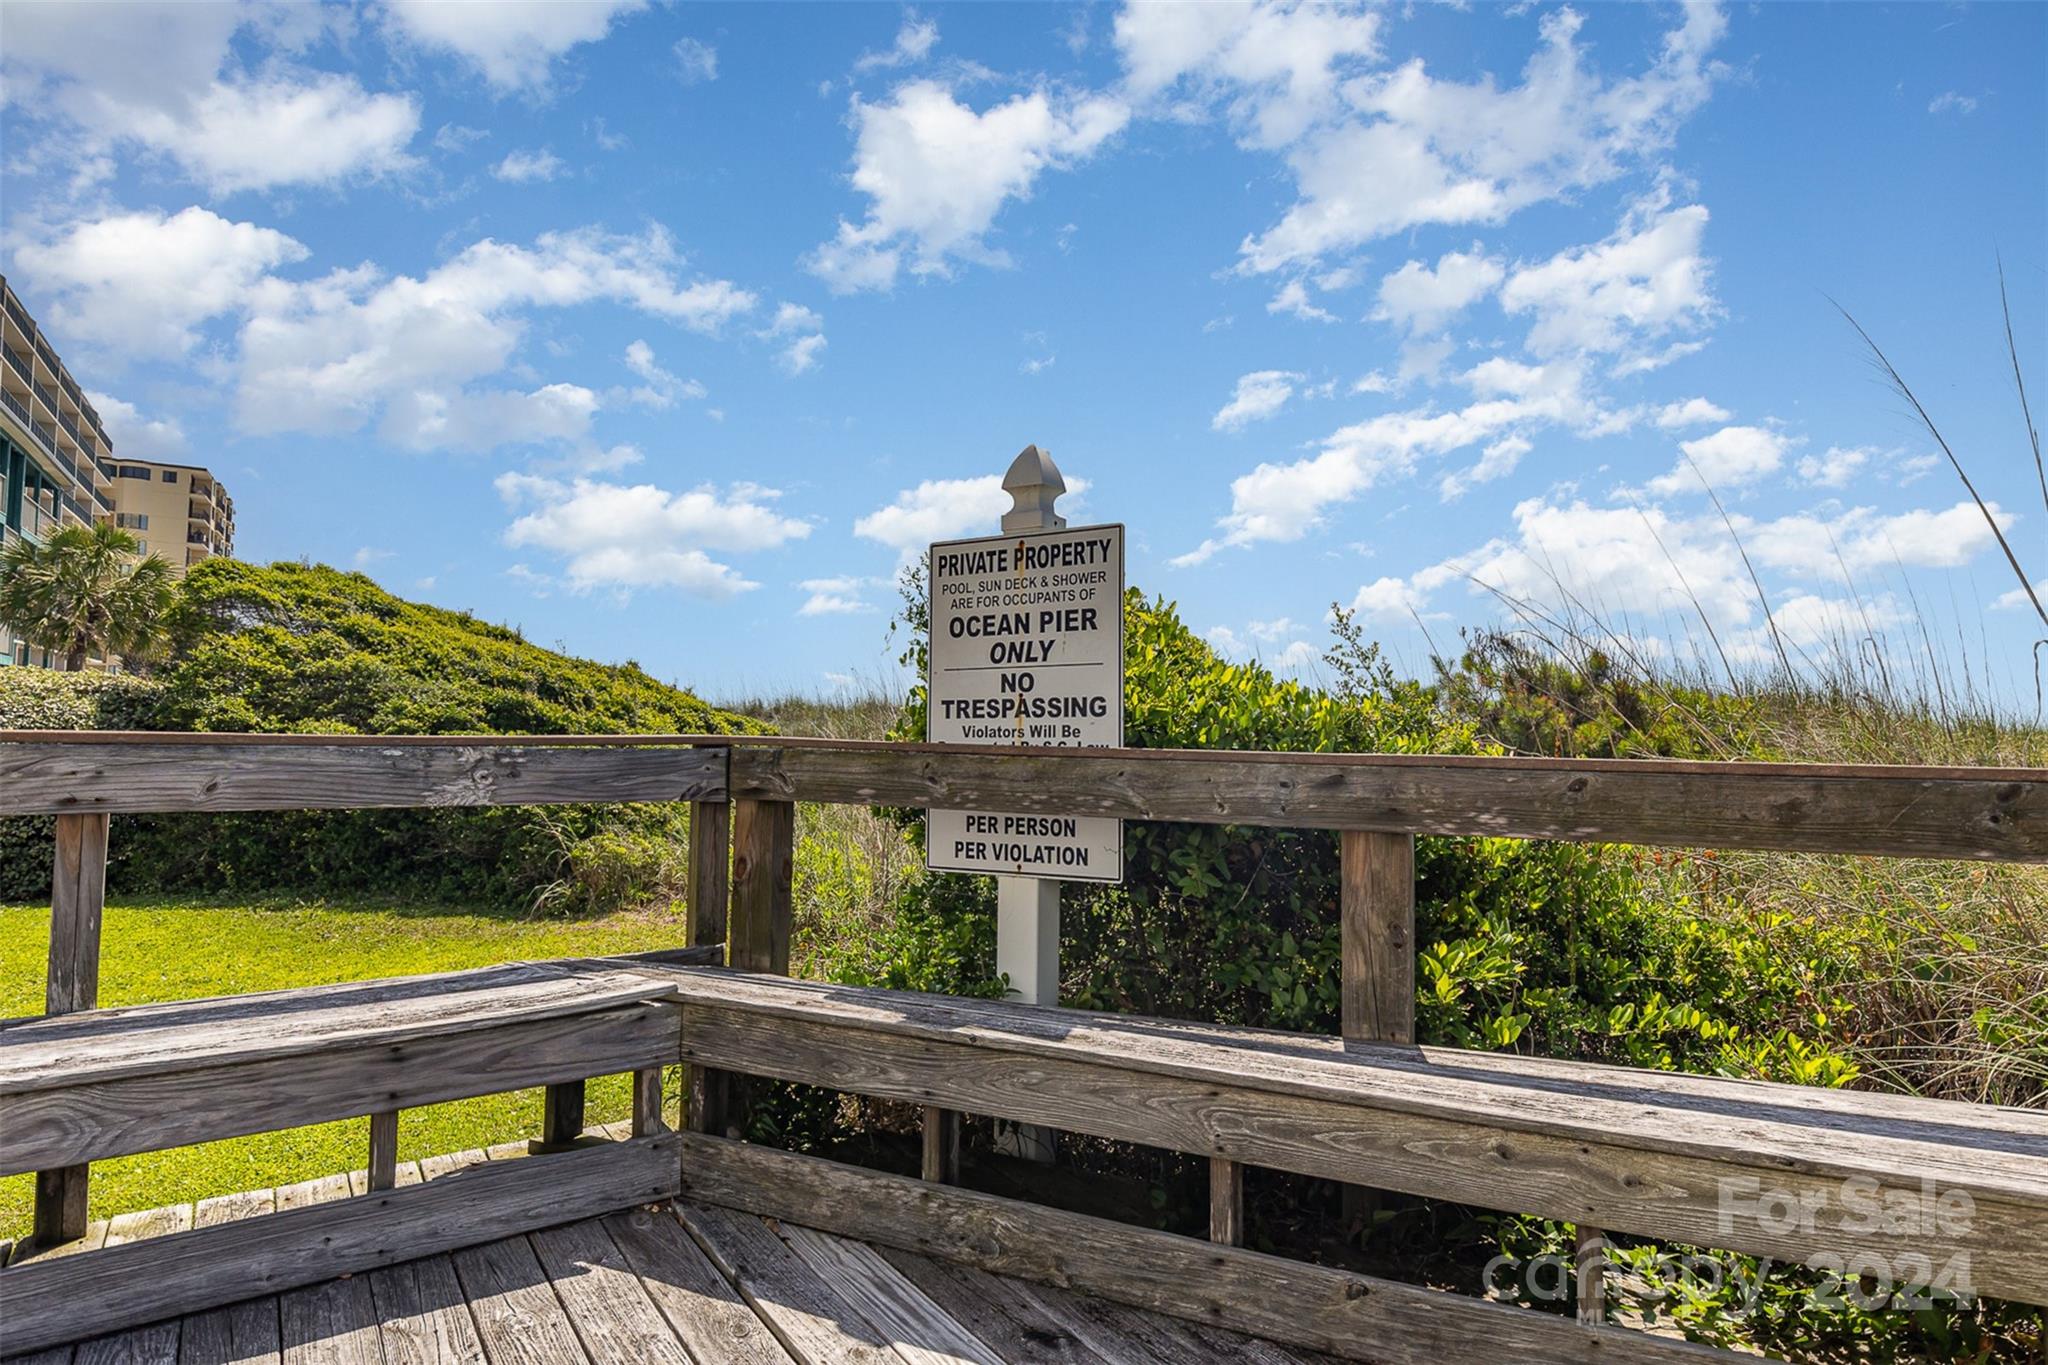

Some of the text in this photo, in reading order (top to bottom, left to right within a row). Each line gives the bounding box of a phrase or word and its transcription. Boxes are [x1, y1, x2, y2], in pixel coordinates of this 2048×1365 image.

[938, 538, 1112, 577] PRIVATE PROPERTY
[942, 570, 1107, 595] POOL, SUN DECK & SHOWER
[950, 588, 1096, 610] ARE FOR OCCUPANTS OF
[949, 608, 1098, 638] OCEAN PIER
[990, 639, 1056, 664] ONLY
[1000, 672, 1035, 693] NO
[941, 696, 1107, 719] TRESPASSING
[962, 725, 1081, 738] Violators Will Be
[966, 815, 1077, 837] PER PERSON
[955, 841, 1089, 866] PER VIOLATION
